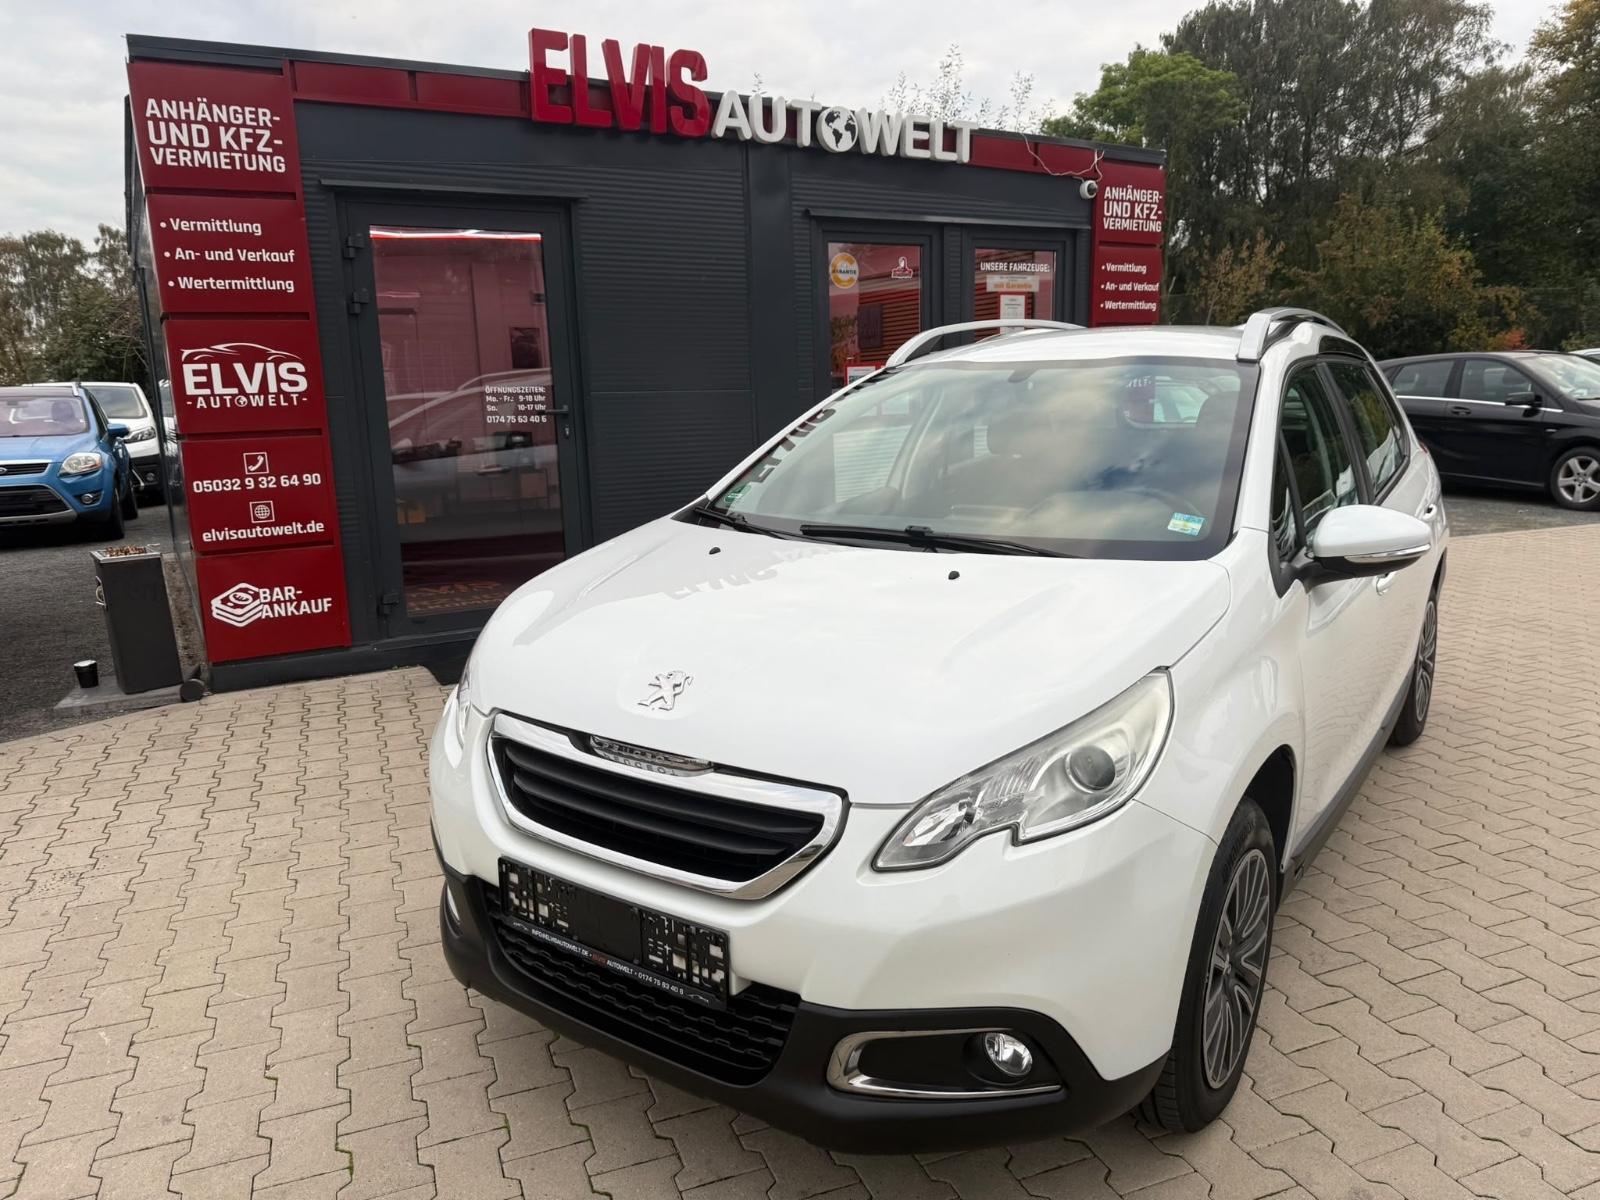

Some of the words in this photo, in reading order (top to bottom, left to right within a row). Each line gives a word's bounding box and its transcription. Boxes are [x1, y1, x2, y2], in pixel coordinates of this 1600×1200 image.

[528, 28, 713, 137] ELVIS
[145, 97, 280, 128] ANHÄNGER-
[148, 121, 210, 149] UND
[219, 126, 283, 153] KFZ-
[150, 148, 286, 173] VERMIETUNG
[1104, 185, 1162, 203] ANHÄNGER-
[1104, 201, 1131, 218] UND
[1134, 203, 1162, 219] KFZ-
[170, 218, 262, 236] Vermittlung
[1103, 217, 1162, 232] VERMIETUNG
[175, 248, 200, 260] An-
[204, 248, 232, 262] und
[237, 249, 295, 263] Verkauf
[980, 262, 1008, 272] UNSERE
[1010, 262, 1050, 272] FAHRZEUGE:
[1106, 263, 1147, 274] Vermittlung
[177, 276, 294, 292] Wertermittlung
[1106, 282, 1117, 291] An-
[1119, 282, 1132, 291] und
[1134, 282, 1160, 292] Verkauf
[1105, 301, 1156, 312] Wertermittlung
[183, 362, 308, 396] ELVIS
[485, 385, 546, 394] ÖFFNUNGSZEITEN:
[193, 479, 242, 493] 05032
[245, 478, 255, 490] 9
[258, 476, 278, 489] 32
[281, 475, 300, 488] 64
[303, 473, 321, 486] 90
[202, 521, 325, 542] elvisautowelt.de
[259, 587, 303, 602] BAR-
[261, 598, 332, 619] ANKAUF
